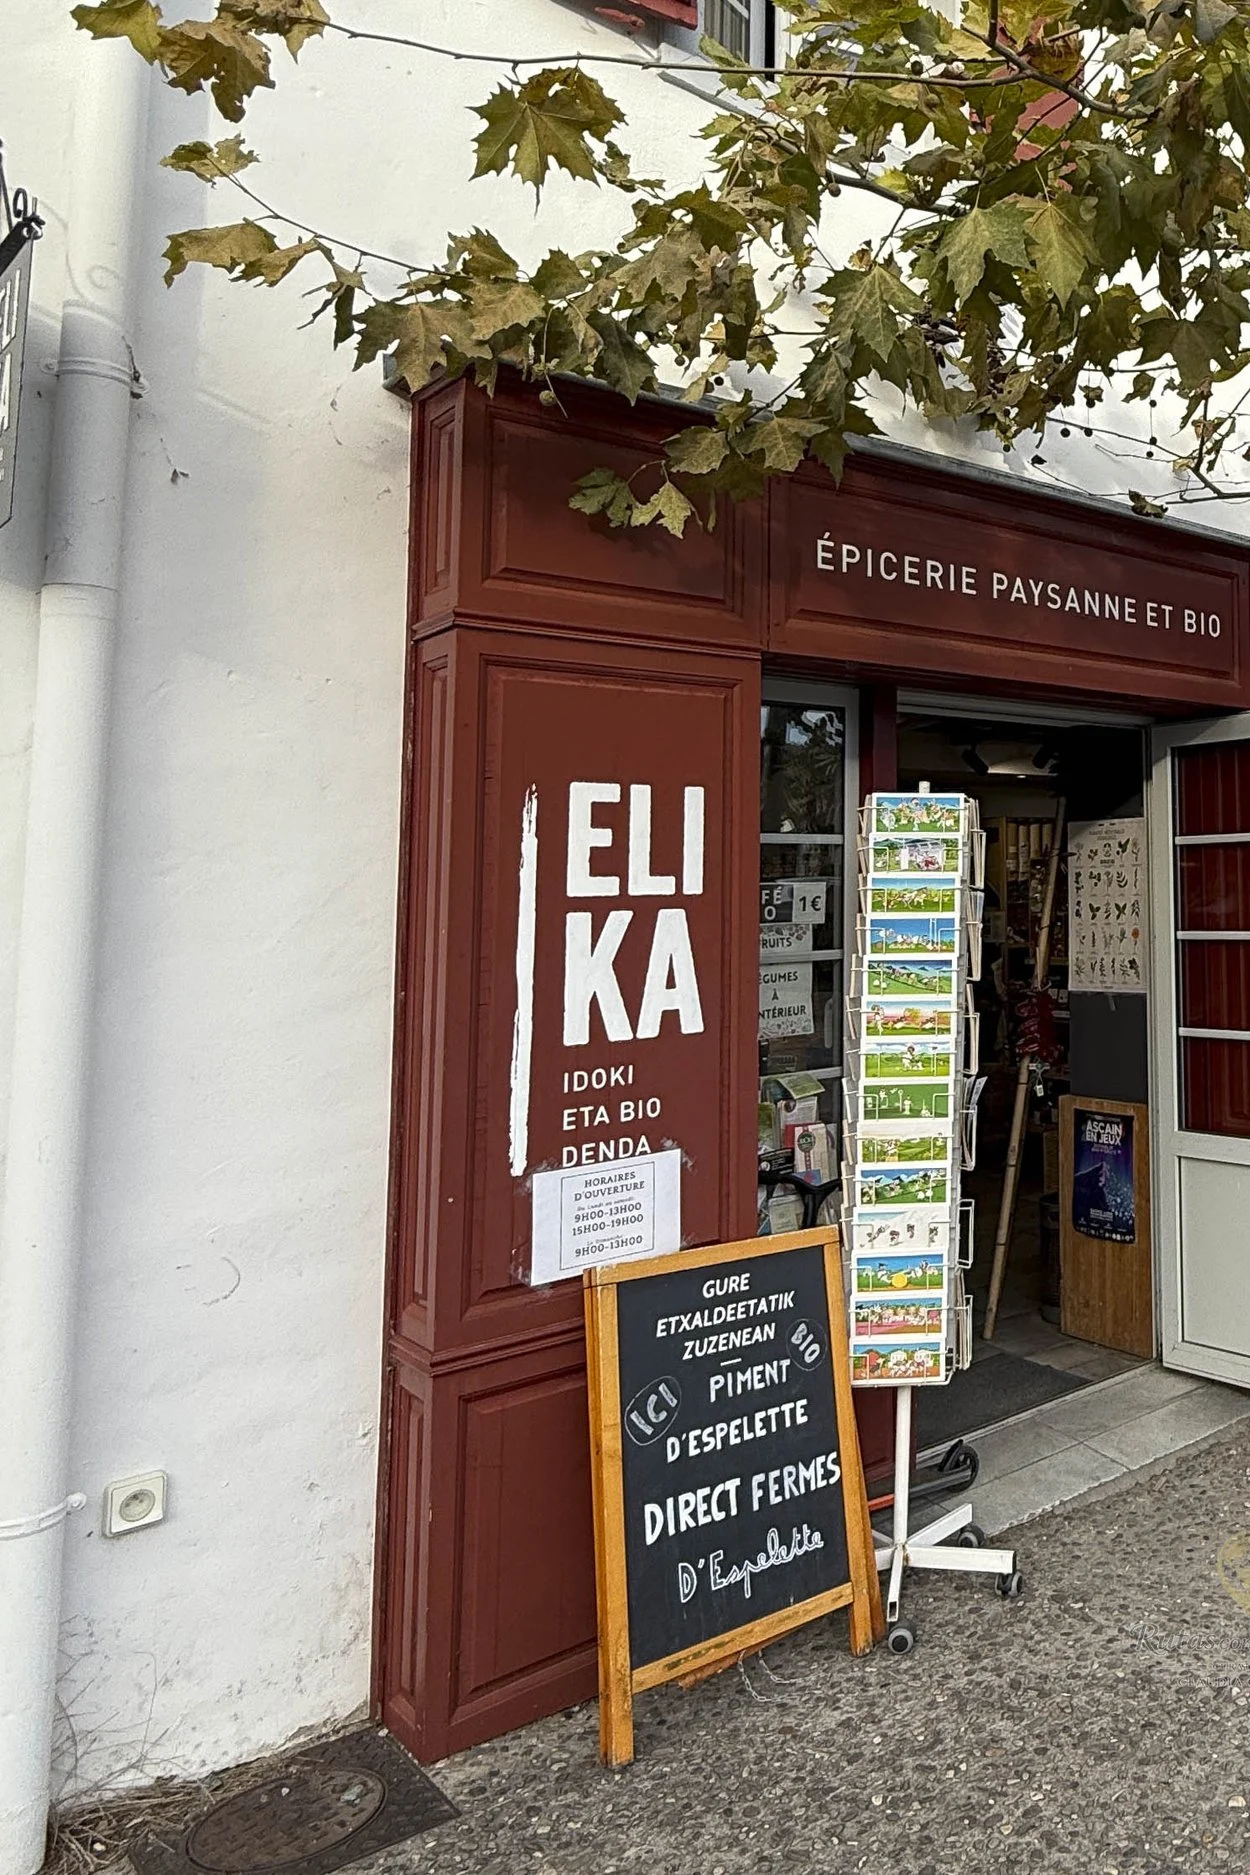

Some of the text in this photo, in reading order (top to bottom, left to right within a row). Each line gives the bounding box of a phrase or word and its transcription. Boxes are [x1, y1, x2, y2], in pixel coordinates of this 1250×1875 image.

[816, 532, 1221, 638] ÉPICERIE PAYSANNE ET BIO
[566, 781, 704, 898] ELI
[799, 895, 822, 912] 1€
[563, 909, 704, 1046] KA
[771, 988, 779, 1001] À
[563, 1065, 634, 1094] IDOKI
[562, 1098, 661, 1131] ETA BIO
[1086, 1119, 1122, 1136] ASCAIN
[562, 1136, 652, 1168] DENDA
[1086, 1131, 1121, 1146] EN JEUX
[574, 1181, 645, 1201] D'OUVERTURE
[584, 1171, 636, 1188] HORAIRES
[572, 1213, 644, 1236] 15H00-19H00
[574, 1202, 642, 1223] 9H00-13H00
[575, 1235, 643, 1258] 9H00-13H00
[702, 1272, 751, 1299] GURE
[655, 1291, 796, 1339] ETXALDEETATIK
[682, 1322, 777, 1361] ZUZENEAN
[791, 1321, 821, 1364] BIO
[709, 1358, 792, 1402] PIMENT
[629, 1381, 679, 1436] ICI
[666, 1398, 810, 1464] D'ESPELETTE
[644, 1451, 842, 1546] DIRECT FERMES
